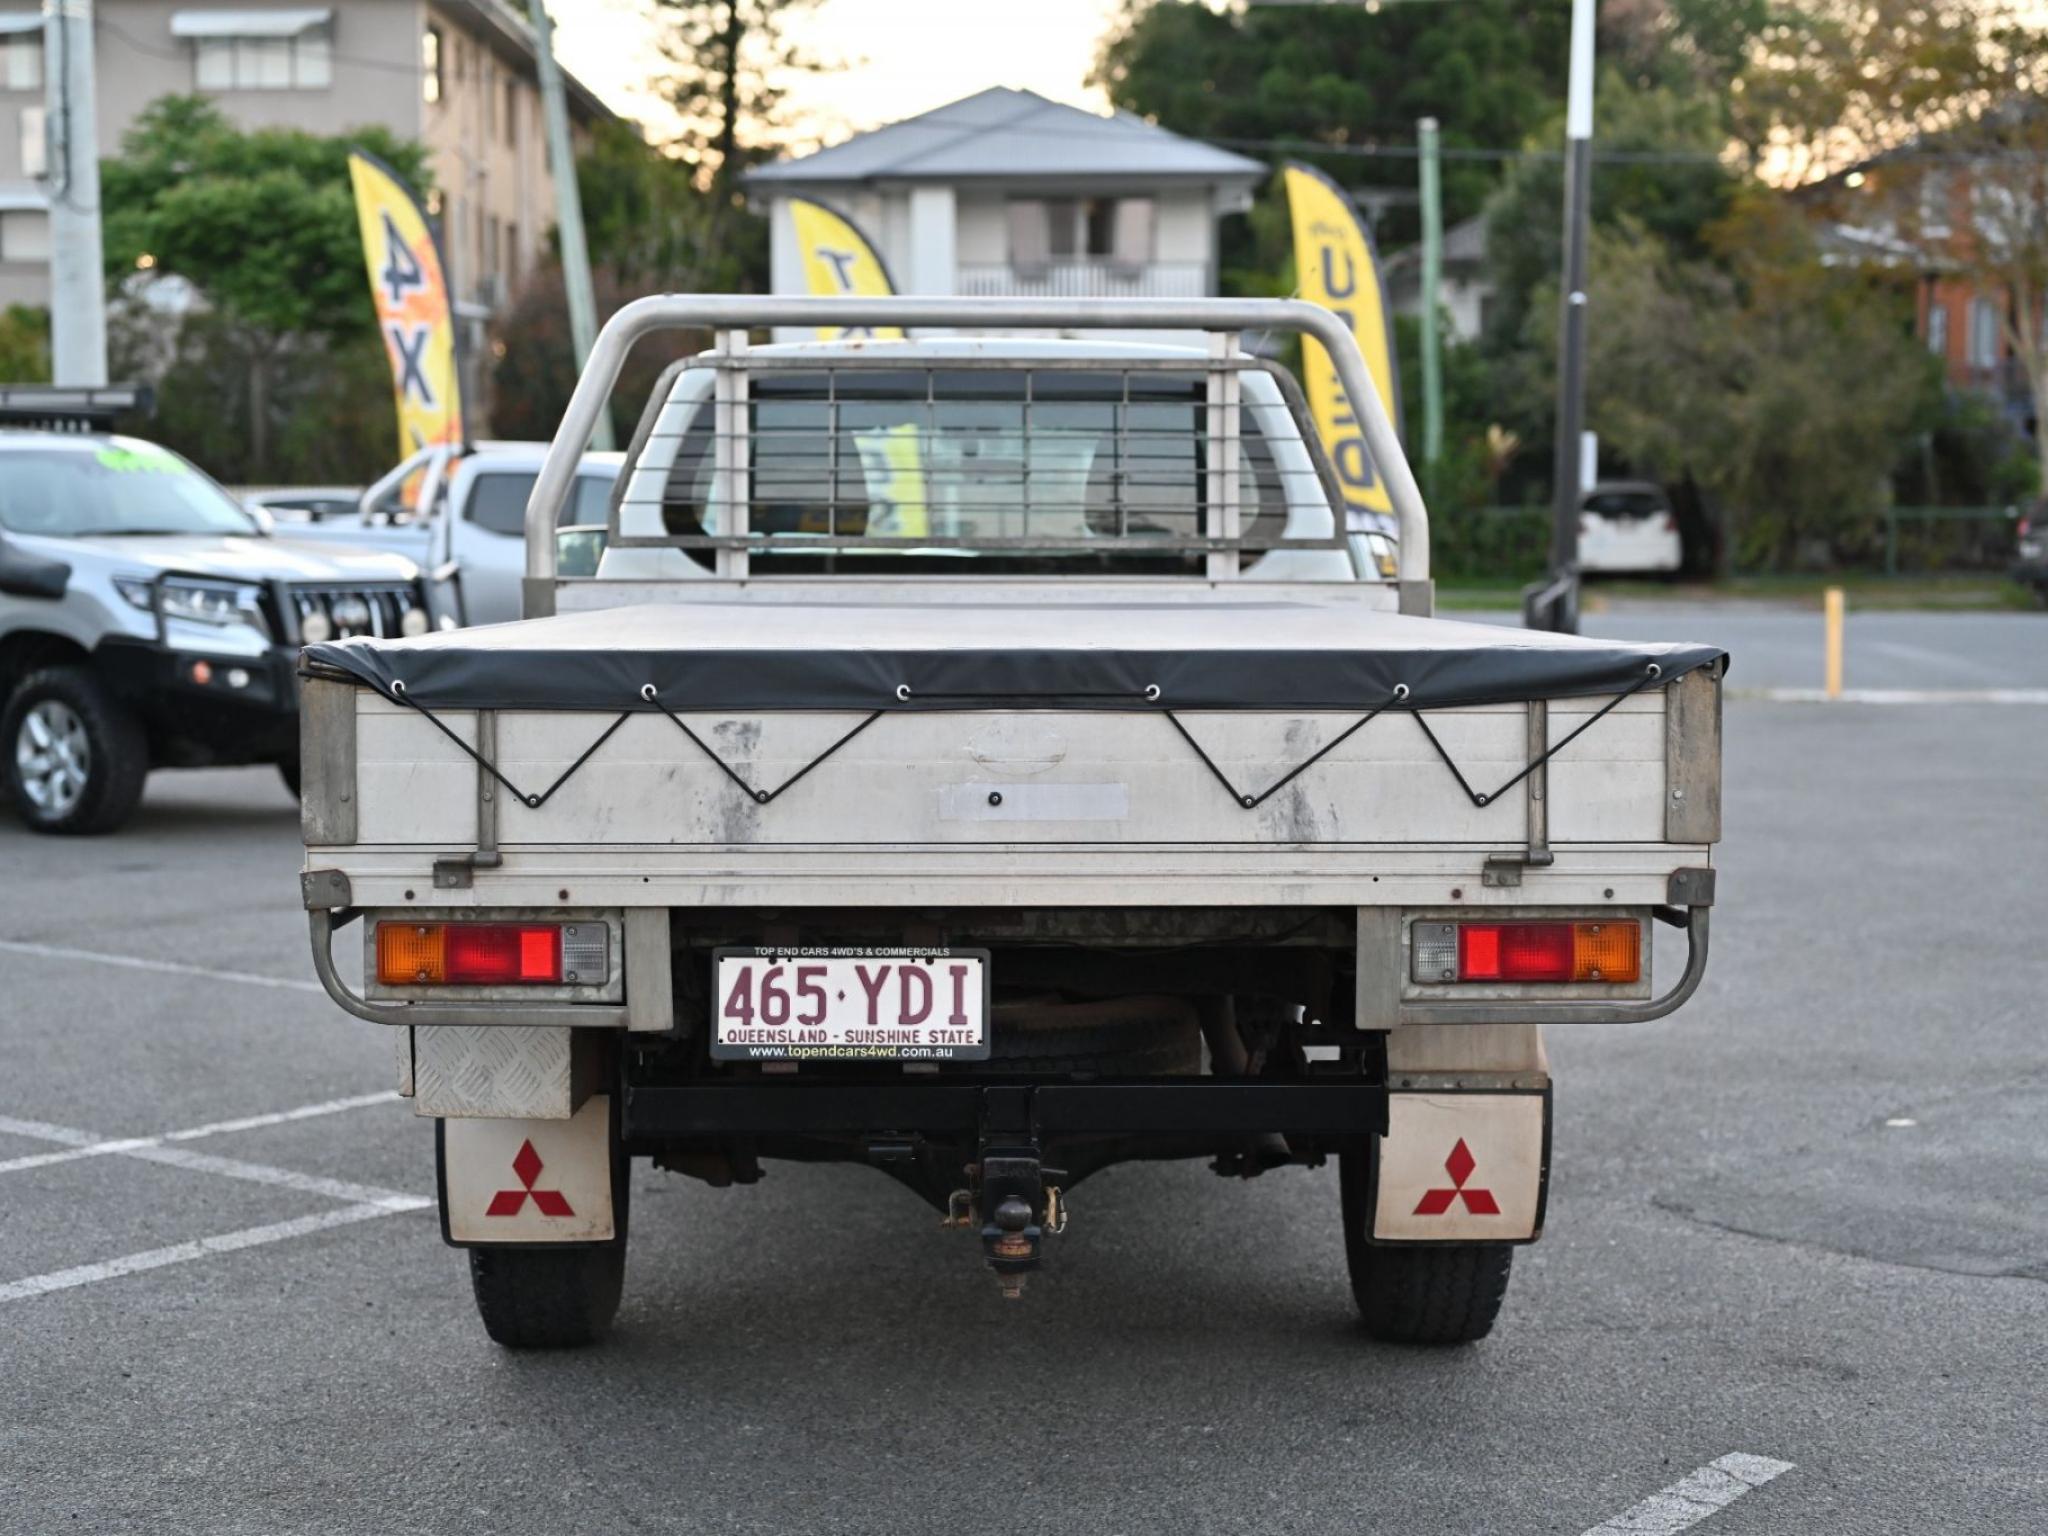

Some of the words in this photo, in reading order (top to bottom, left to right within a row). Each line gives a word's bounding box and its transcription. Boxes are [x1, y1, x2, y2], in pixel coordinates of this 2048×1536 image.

[754, 947, 775, 956] TOP
[777, 947, 799, 956] END
[801, 947, 829, 956] CARS
[830, 947, 864, 956] 4WD'S
[865, 947, 873, 956] &
[875, 947, 950, 956] COMMERCIALS
[727, 1030, 828, 1043] QUEENSLAND
[844, 1030, 920, 1044] SUNSHINE
[928, 1030, 974, 1044] STATE
[749, 1045, 953, 1059] www.topendcars4wd.com.au
